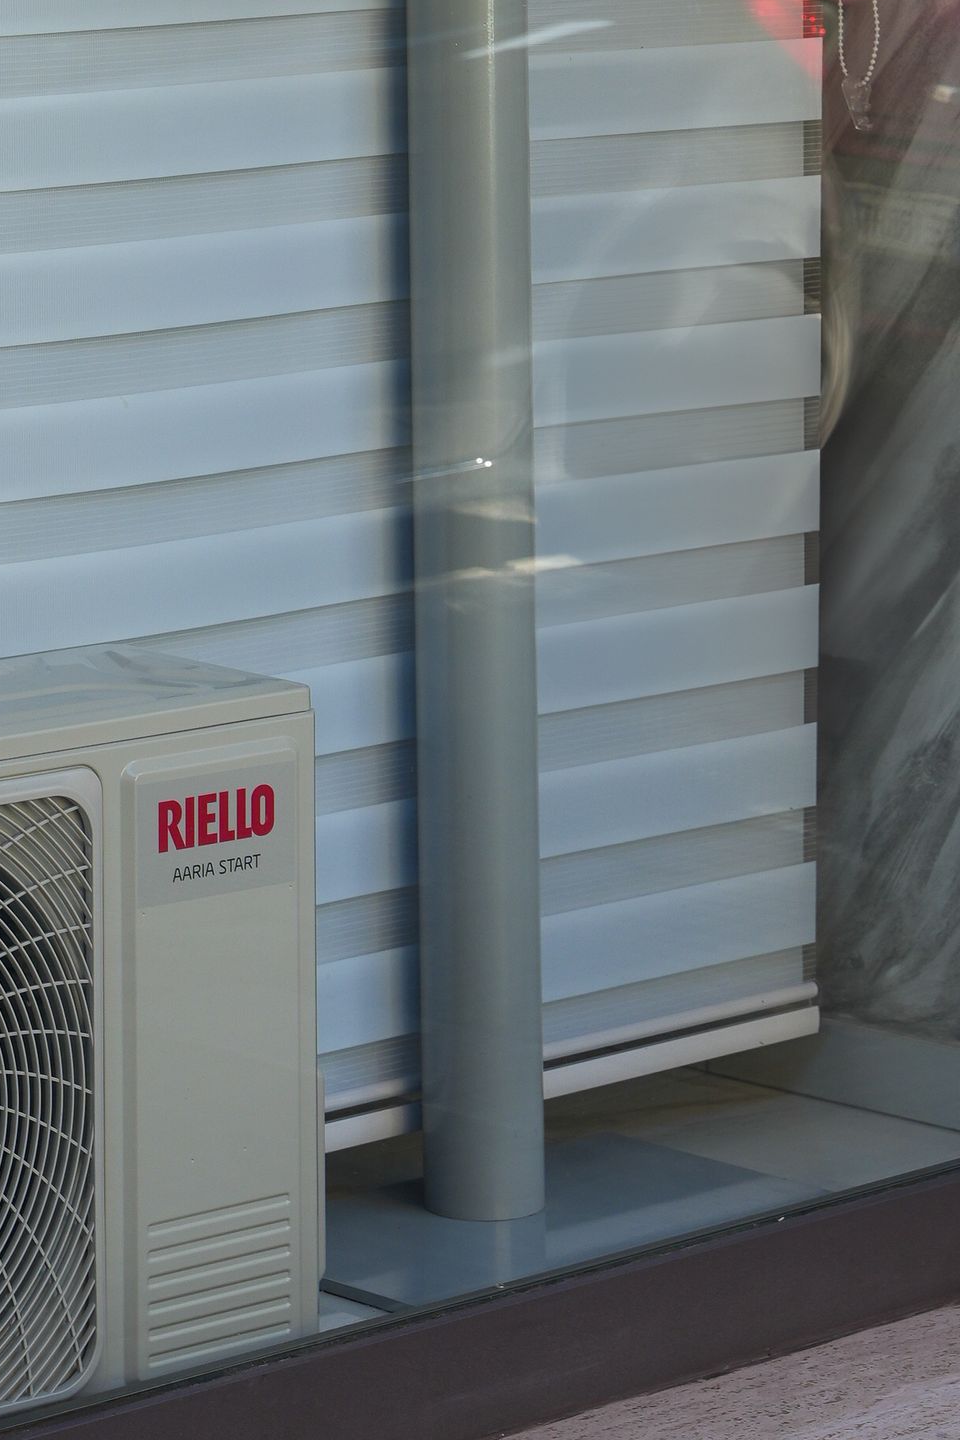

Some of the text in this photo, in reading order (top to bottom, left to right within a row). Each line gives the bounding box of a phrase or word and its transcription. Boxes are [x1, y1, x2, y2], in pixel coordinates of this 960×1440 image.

[158, 783, 275, 854] RIELLO
[172, 854, 261, 883] AARIA START
